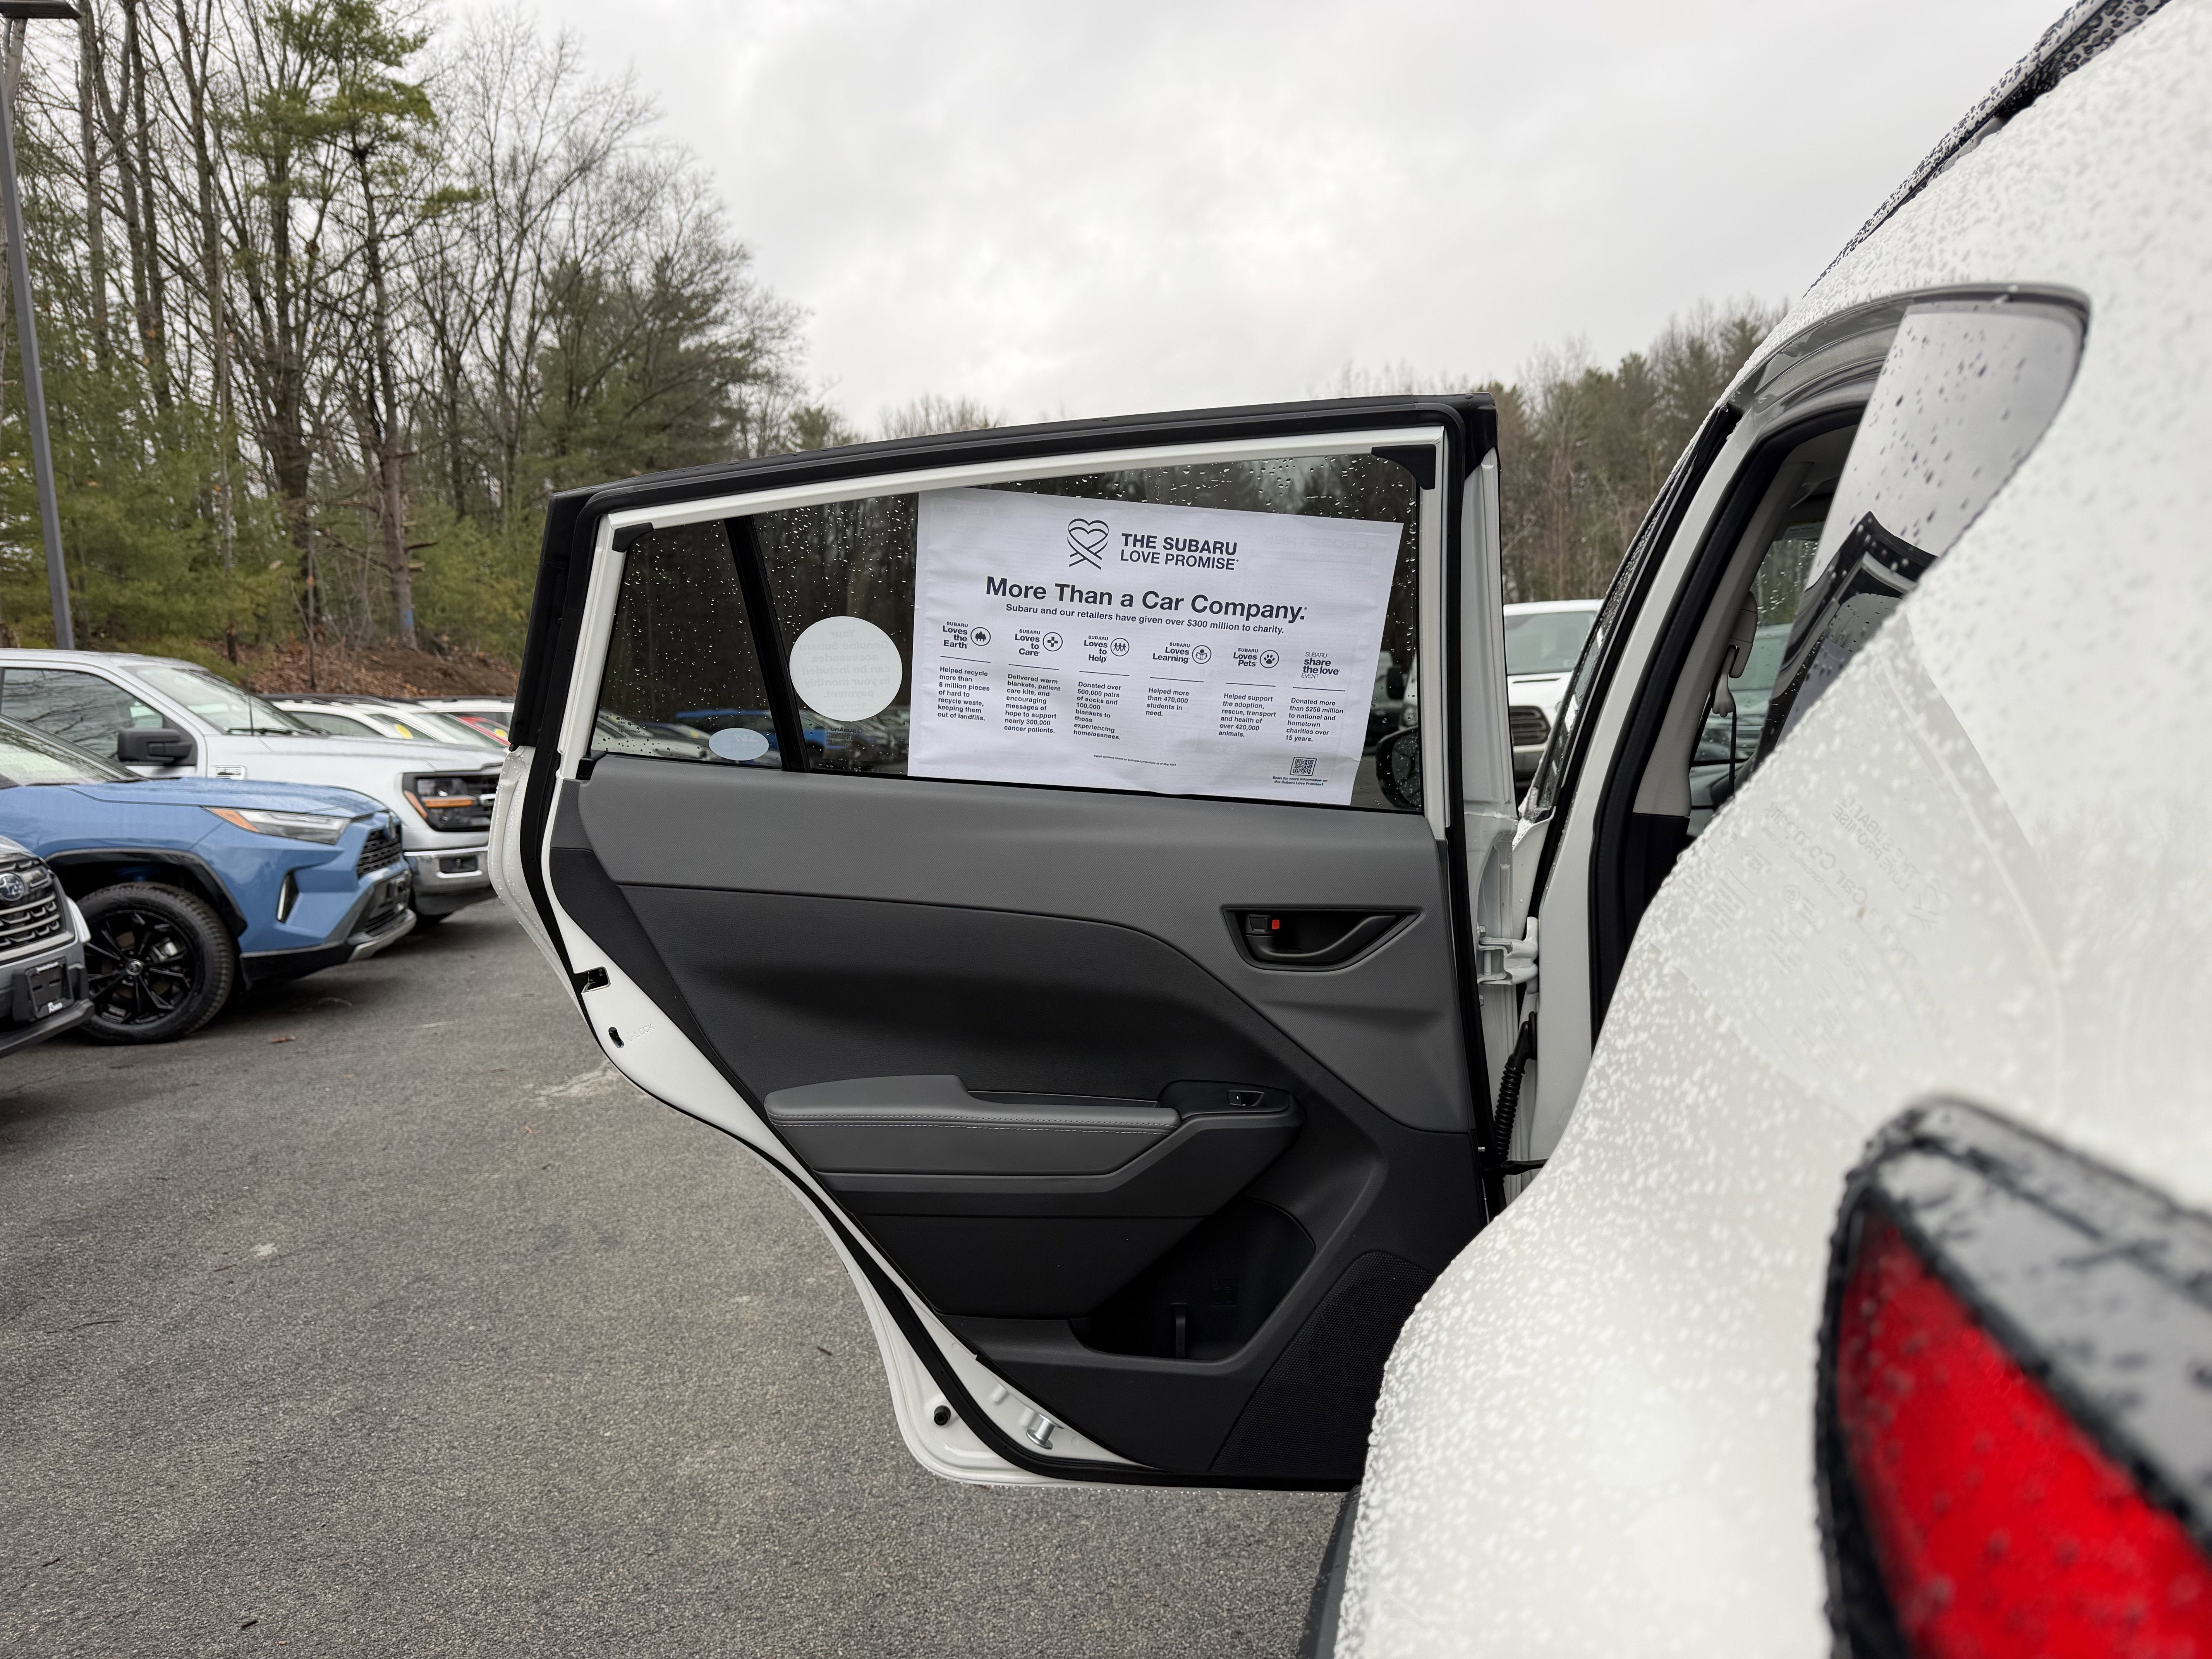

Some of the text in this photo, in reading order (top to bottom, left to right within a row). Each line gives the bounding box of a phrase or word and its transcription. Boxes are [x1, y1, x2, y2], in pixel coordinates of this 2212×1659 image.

[1121, 533, 1237, 555] THE SUBARU
[1121, 550, 1235, 570] LOVE PROMISE
[986, 576, 1304, 623] More Than a Car Company.
[1006, 604, 1037, 613] Subaru
[1077, 611, 1113, 620] retailers
[1116, 613, 1136, 622] have
[1139, 616, 1162, 624] given
[1187, 619, 1207, 628] $300
[1210, 622, 1239, 630] million
[1253, 625, 1284, 635] charity.
[943, 625, 968, 635] Loves
[1015, 634, 1039, 642] Loves
[944, 640, 967, 649] Earth
[1084, 640, 1108, 648] Loves
[1165, 647, 1189, 655] Loves
[1089, 654, 1106, 663] Help
[1153, 653, 1188, 664] Learning
[1304, 658, 1331, 666] share
[1320, 666, 1339, 675] love
[1008, 680, 1036, 689] blankets,
[1006, 696, 1046, 704] encouraging
[938, 704, 963, 713] keeping
[1074, 723, 1115, 733] experiencing
[1073, 730, 1120, 740] homelessness.
[634, 1023, 655, 1037] LOCK
